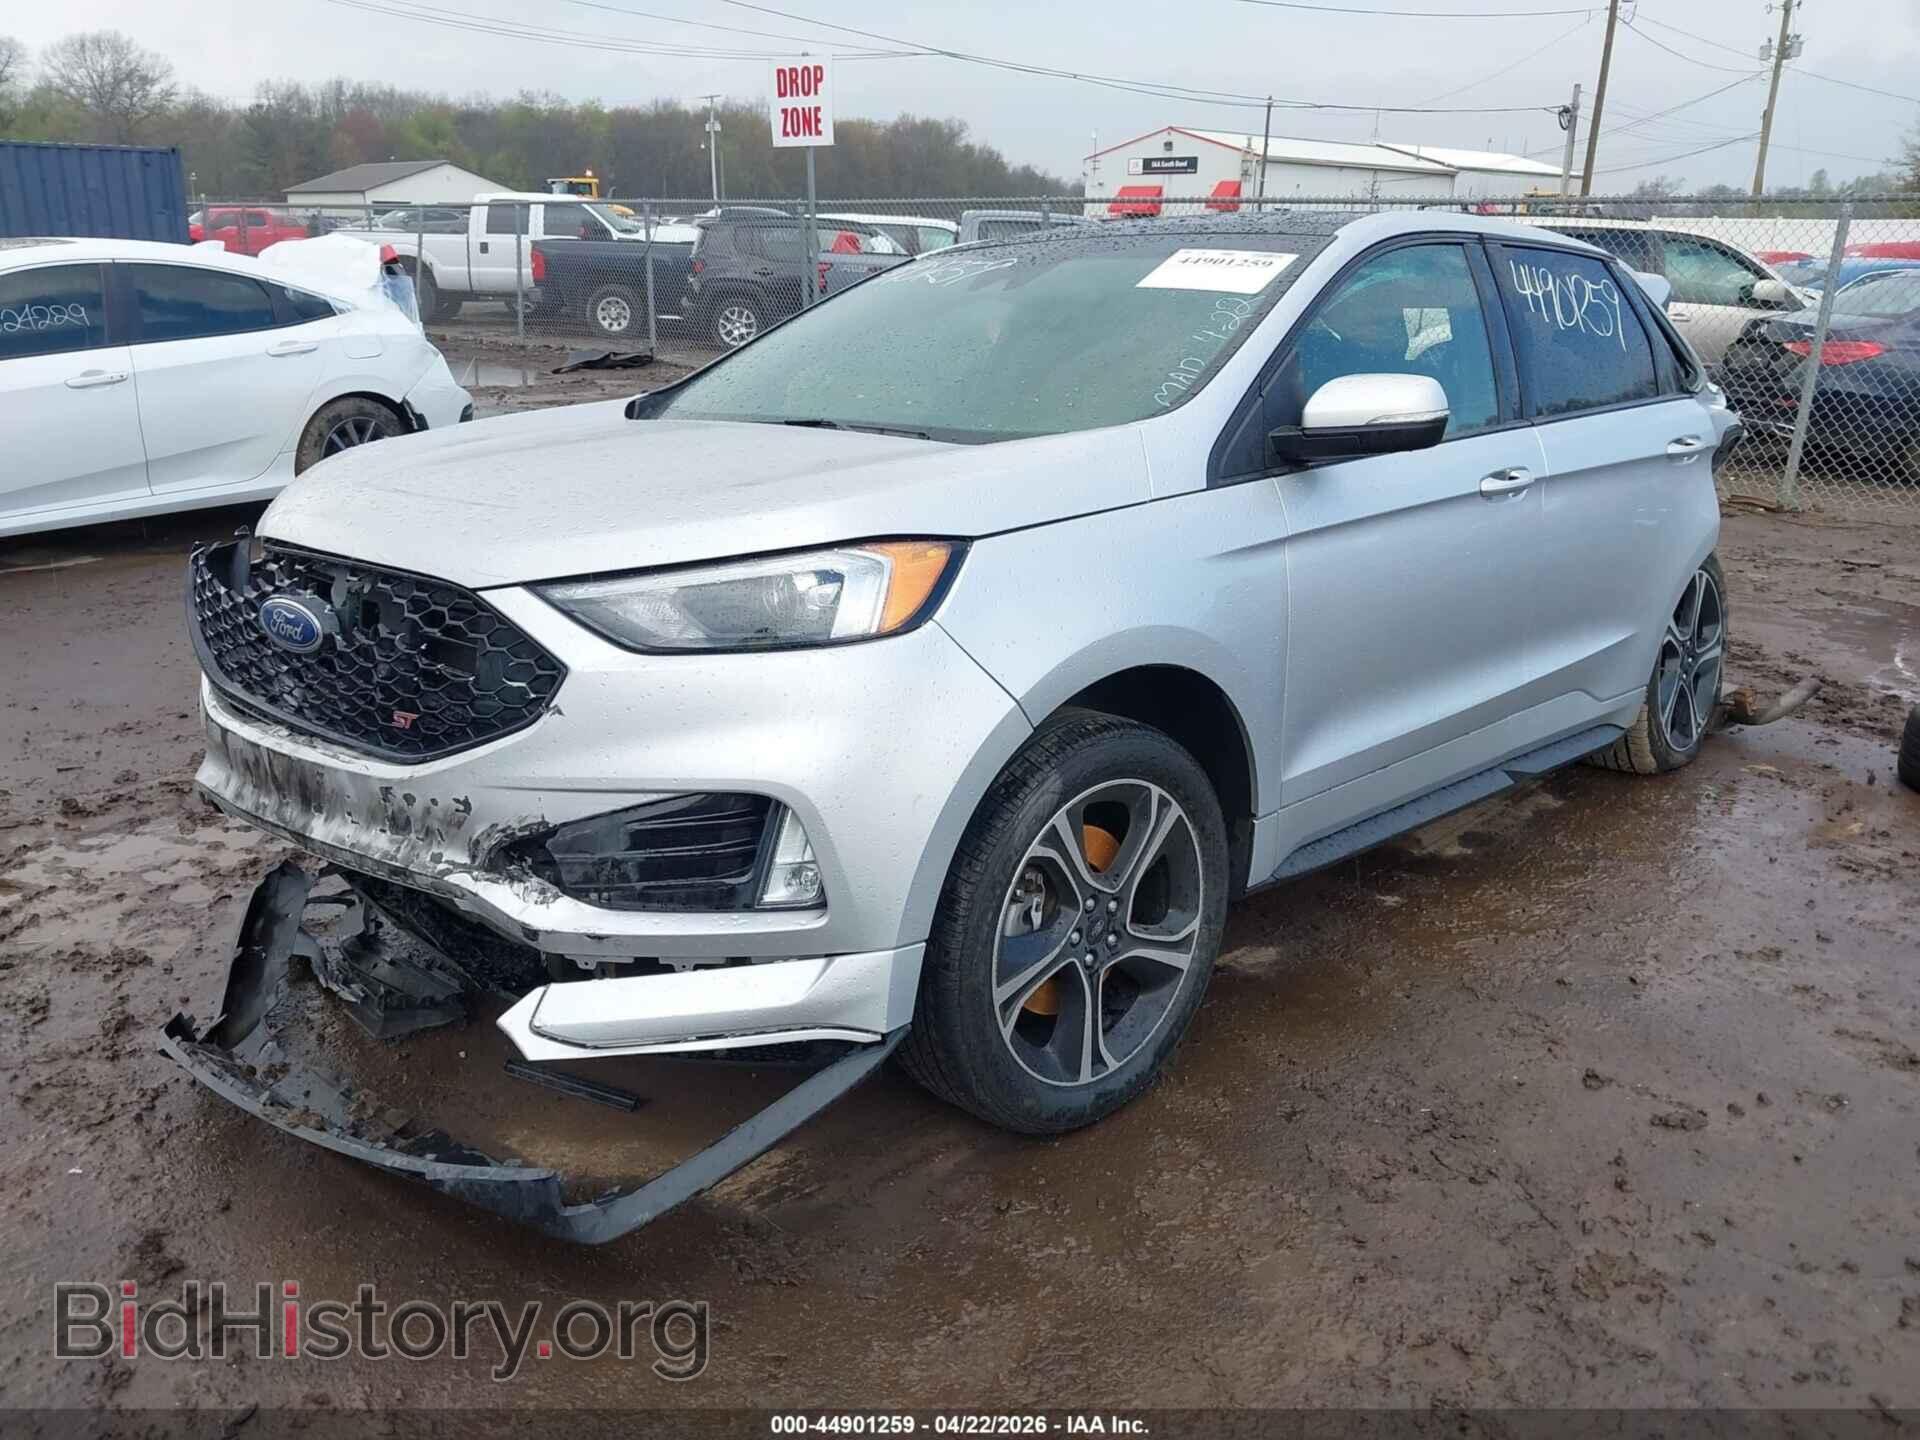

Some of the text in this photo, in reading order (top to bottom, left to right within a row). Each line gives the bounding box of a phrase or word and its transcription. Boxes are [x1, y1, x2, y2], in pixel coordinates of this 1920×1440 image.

[776, 65, 823, 98] DROP
[781, 106, 822, 137] ZONE
[270, 608, 305, 641] Ford
[392, 710, 417, 729] ST
